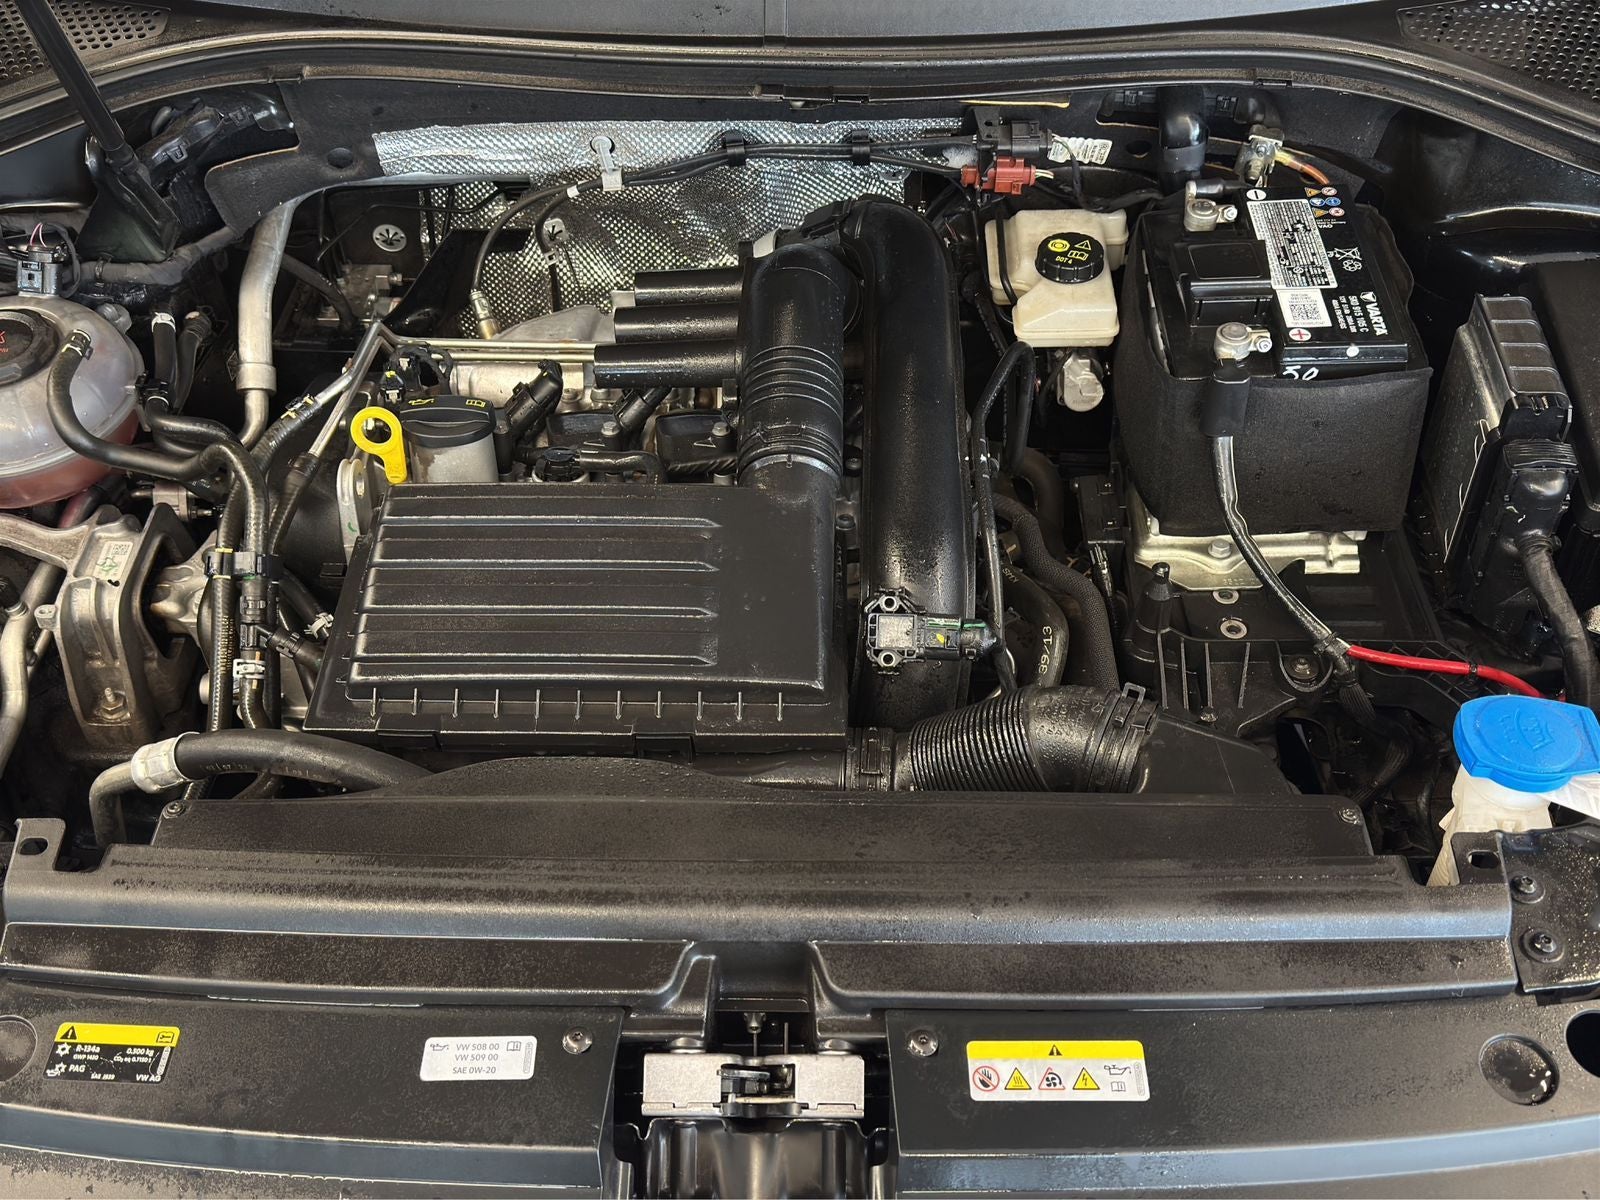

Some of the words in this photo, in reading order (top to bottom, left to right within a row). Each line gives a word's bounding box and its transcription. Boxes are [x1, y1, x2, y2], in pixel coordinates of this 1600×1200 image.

[1366, 303, 1388, 336] VARTA
[1038, 625, 1053, 675] 39/13
[75, 1044, 100, 1053] R-134a
[456, 1043, 469, 1051] VW
[471, 1043, 487, 1051] 508
[488, 1043, 500, 1051] 00
[145, 1048, 155, 1057] kg
[487, 1053, 499, 1061] 00
[68, 1064, 86, 1073] PAG
[452, 1066, 467, 1074] SAE
[468, 1066, 497, 1074] 0W-20
[149, 1074, 161, 1082] AG
